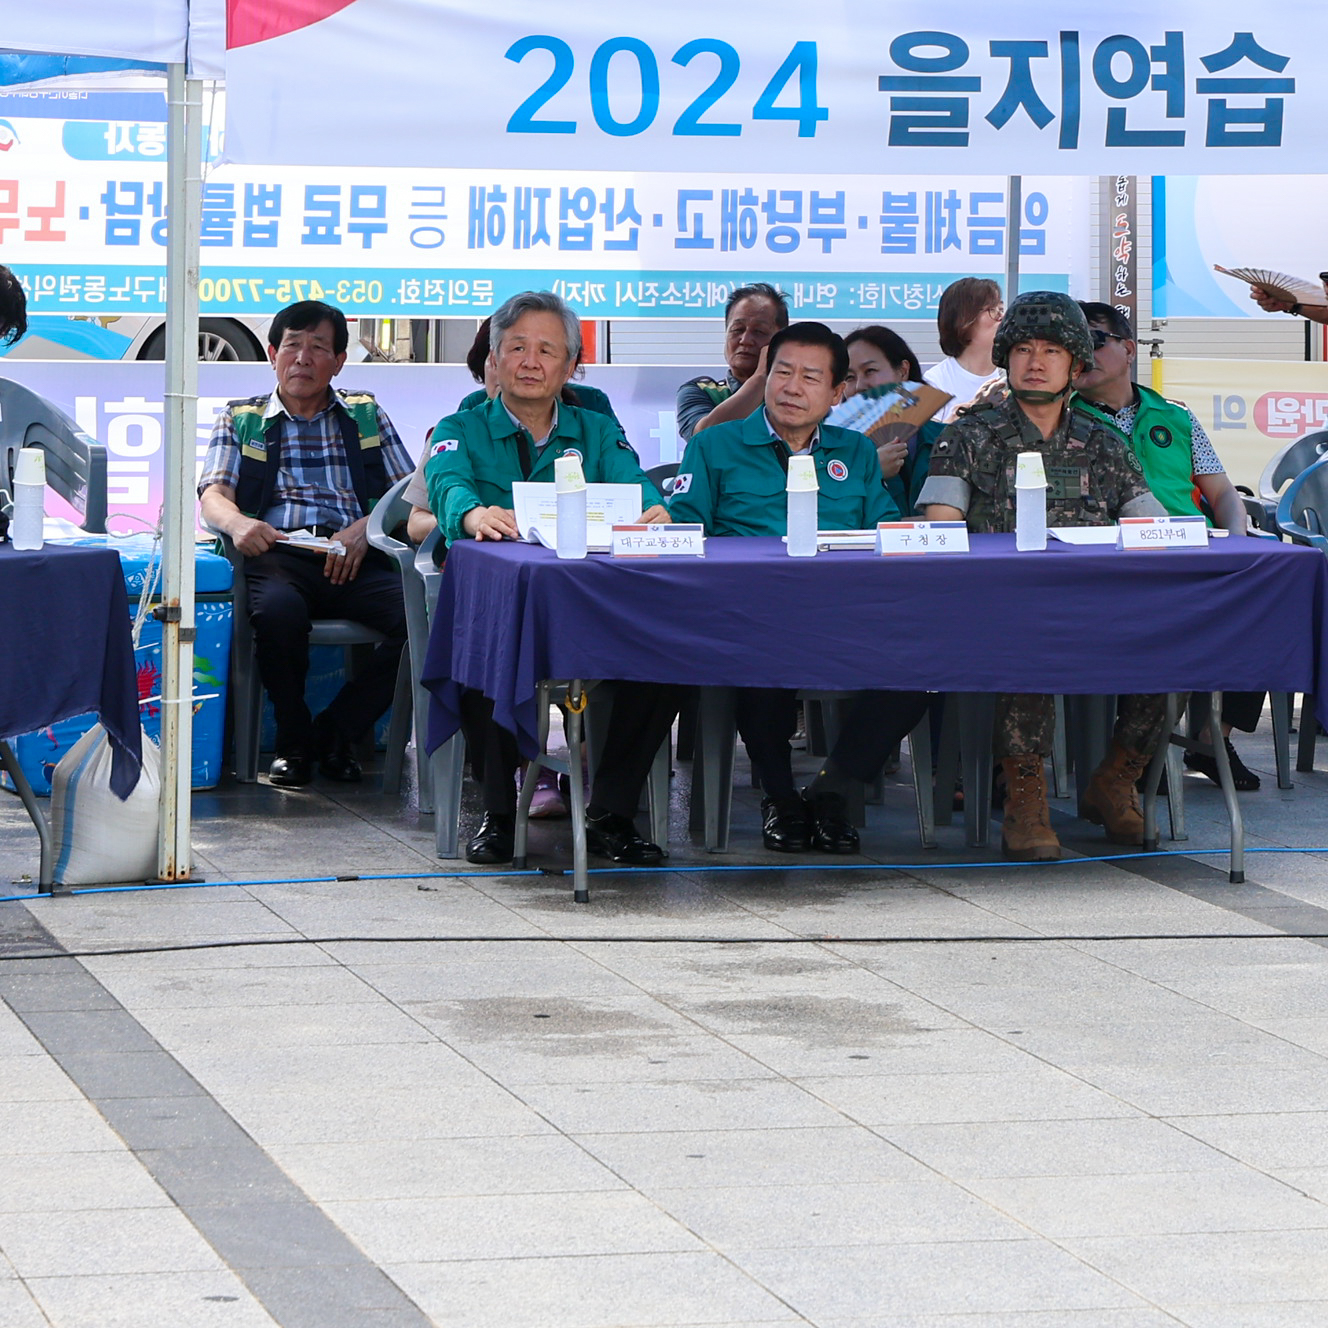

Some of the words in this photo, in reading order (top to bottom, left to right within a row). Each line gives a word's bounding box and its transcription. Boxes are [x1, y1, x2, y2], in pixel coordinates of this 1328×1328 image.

[503, 33, 829, 139] 2024
[877, 27, 1296, 150] 을지연습
[1139, 527, 1187, 541] 8251부대
[620, 535, 694, 549] 대구교통공사
